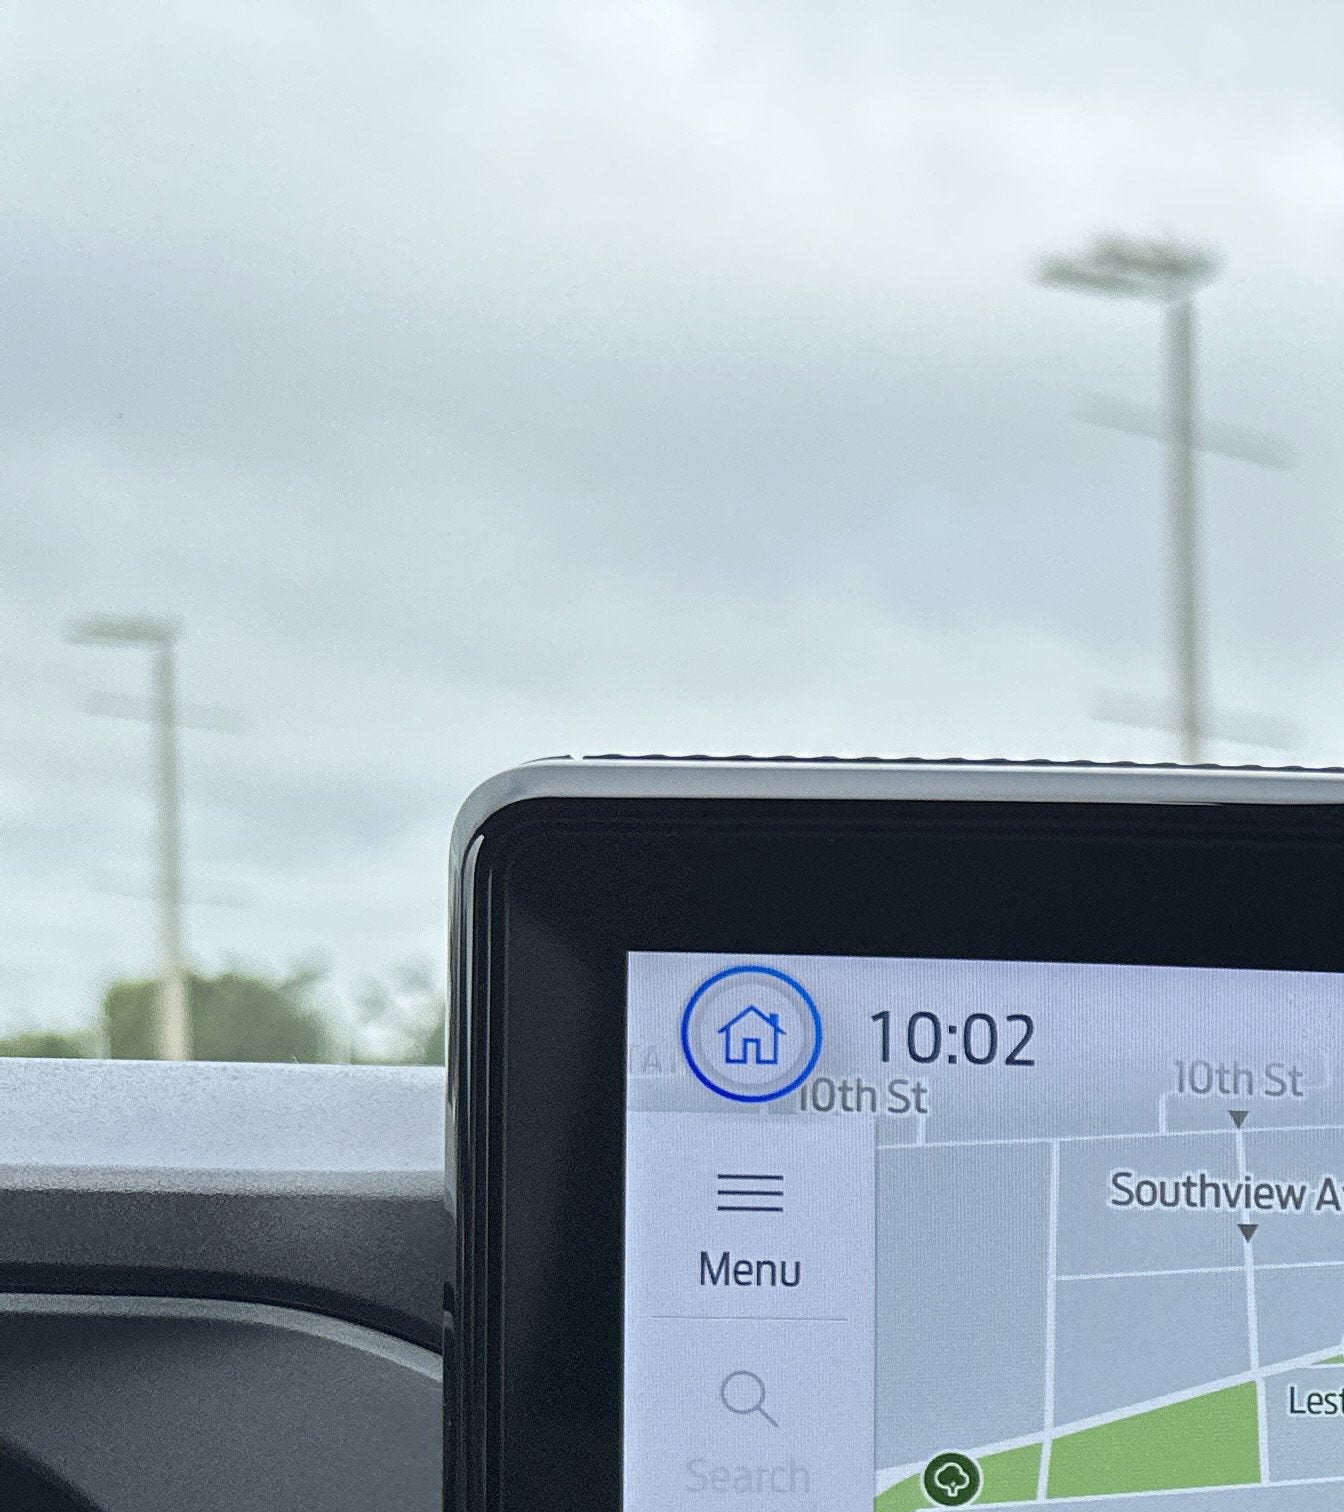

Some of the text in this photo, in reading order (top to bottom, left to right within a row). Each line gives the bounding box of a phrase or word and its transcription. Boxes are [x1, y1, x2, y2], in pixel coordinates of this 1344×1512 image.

[870, 1010, 1036, 1068] 10:02
[800, 1076, 928, 1114] 10th St
[1174, 1059, 1305, 1098] 10th St
[1110, 1171, 1307, 1211] Southview
[699, 1250, 802, 1289] Menu
[685, 1456, 811, 1495] Search
